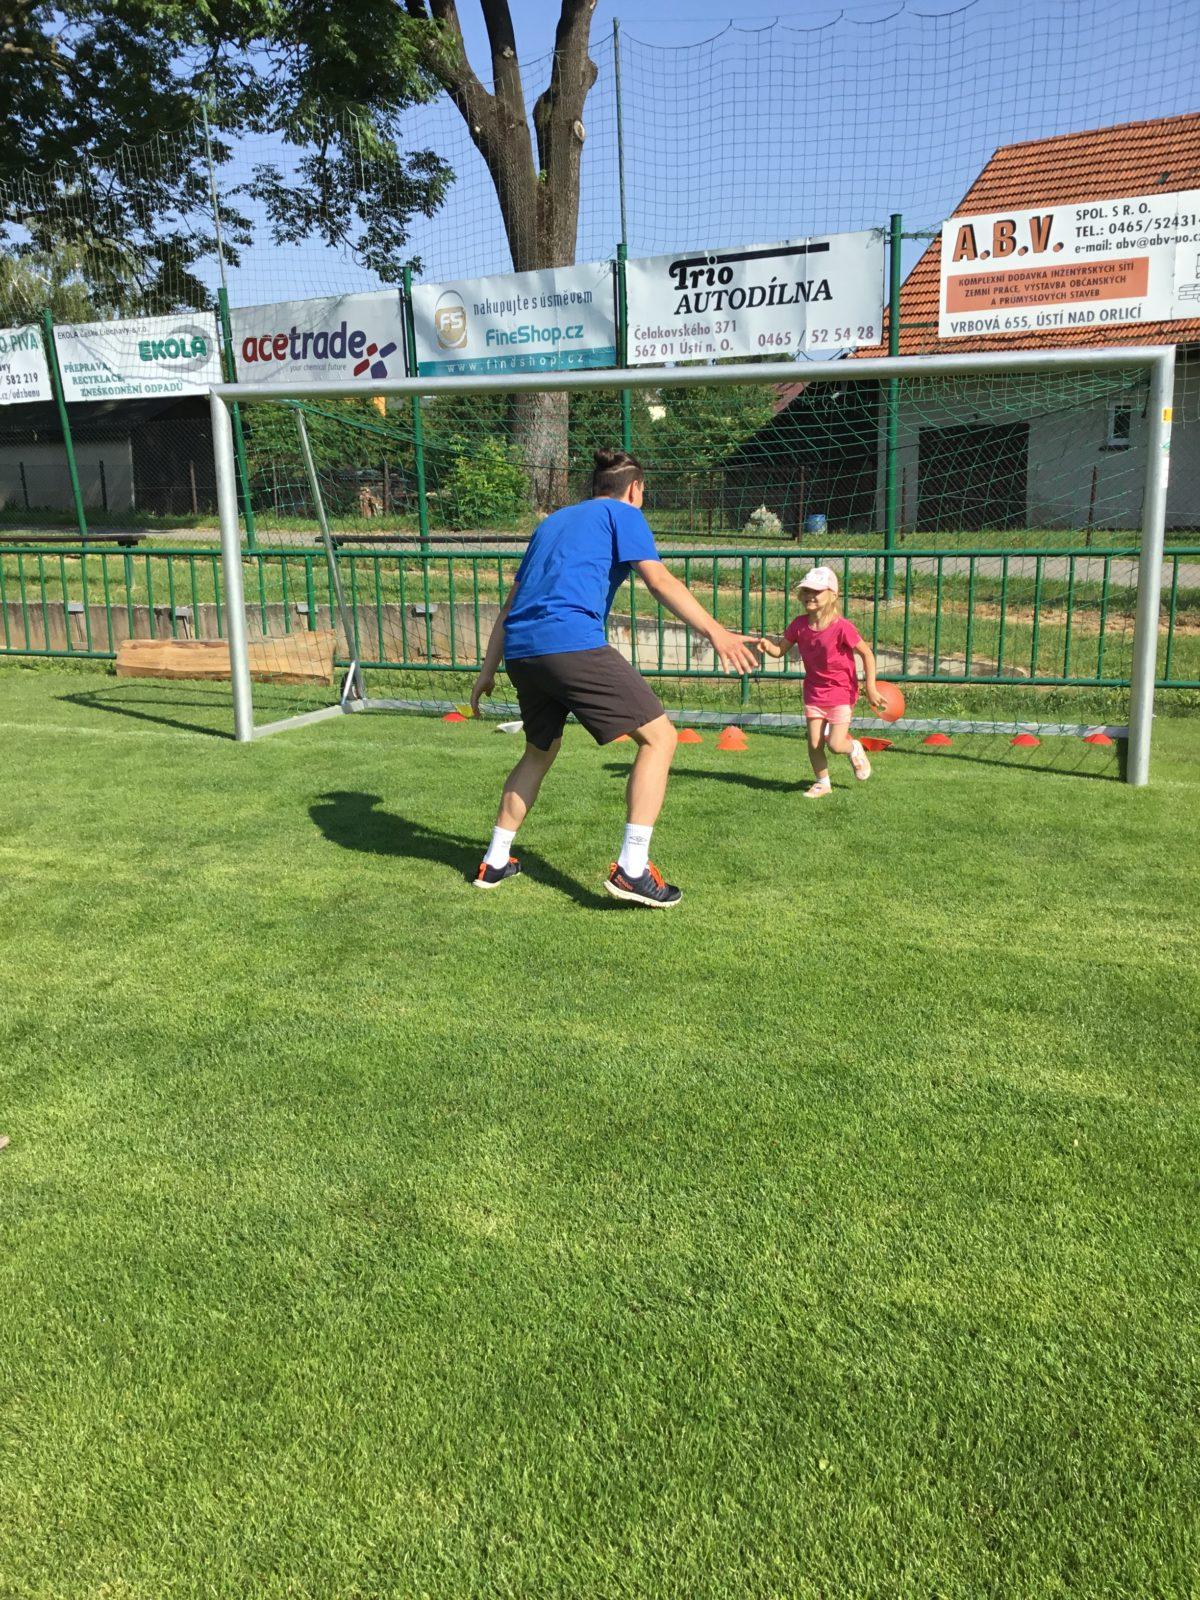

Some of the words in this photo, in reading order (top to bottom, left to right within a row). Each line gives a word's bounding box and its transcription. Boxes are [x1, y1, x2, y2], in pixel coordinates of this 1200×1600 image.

[1075, 208, 1108, 221] SPOL.
[1112, 205, 1119, 217] S
[1123, 204, 1135, 216] R.
[1138, 202, 1151, 214] O.
[953, 213, 1065, 263] A.B.V.
[1075, 226, 1104, 238] TEL.:
[1074, 239, 1113, 254] e-mail:
[673, 276, 834, 316] AUTODÍLNA
[1070, 288, 1101, 299] STAVEB
[950, 315, 1001, 334] VRBOVÁ
[1004, 315, 1033, 330] 655,
[1036, 309, 1065, 327] ÚSTÍ
[1067, 309, 1096, 324] NAD
[1098, 303, 1143, 322] ORLICÍ
[634, 322, 711, 341] Čelakovského
[714, 319, 738, 334] 371
[757, 331, 793, 348] 0465
[811, 329, 829, 344] 52
[834, 327, 852, 342] 54
[856, 325, 875, 340] 28
[10, 332, 40, 352] PIVA
[137, 335, 208, 362] EKOLA
[242, 321, 367, 363] acetrade
[634, 344, 657, 358] 562
[660, 342, 675, 356] 01
[705, 343, 717, 353] n.
[720, 338, 735, 351] O.
[6, 374, 22, 386] 582
[23, 371, 39, 384] 219
